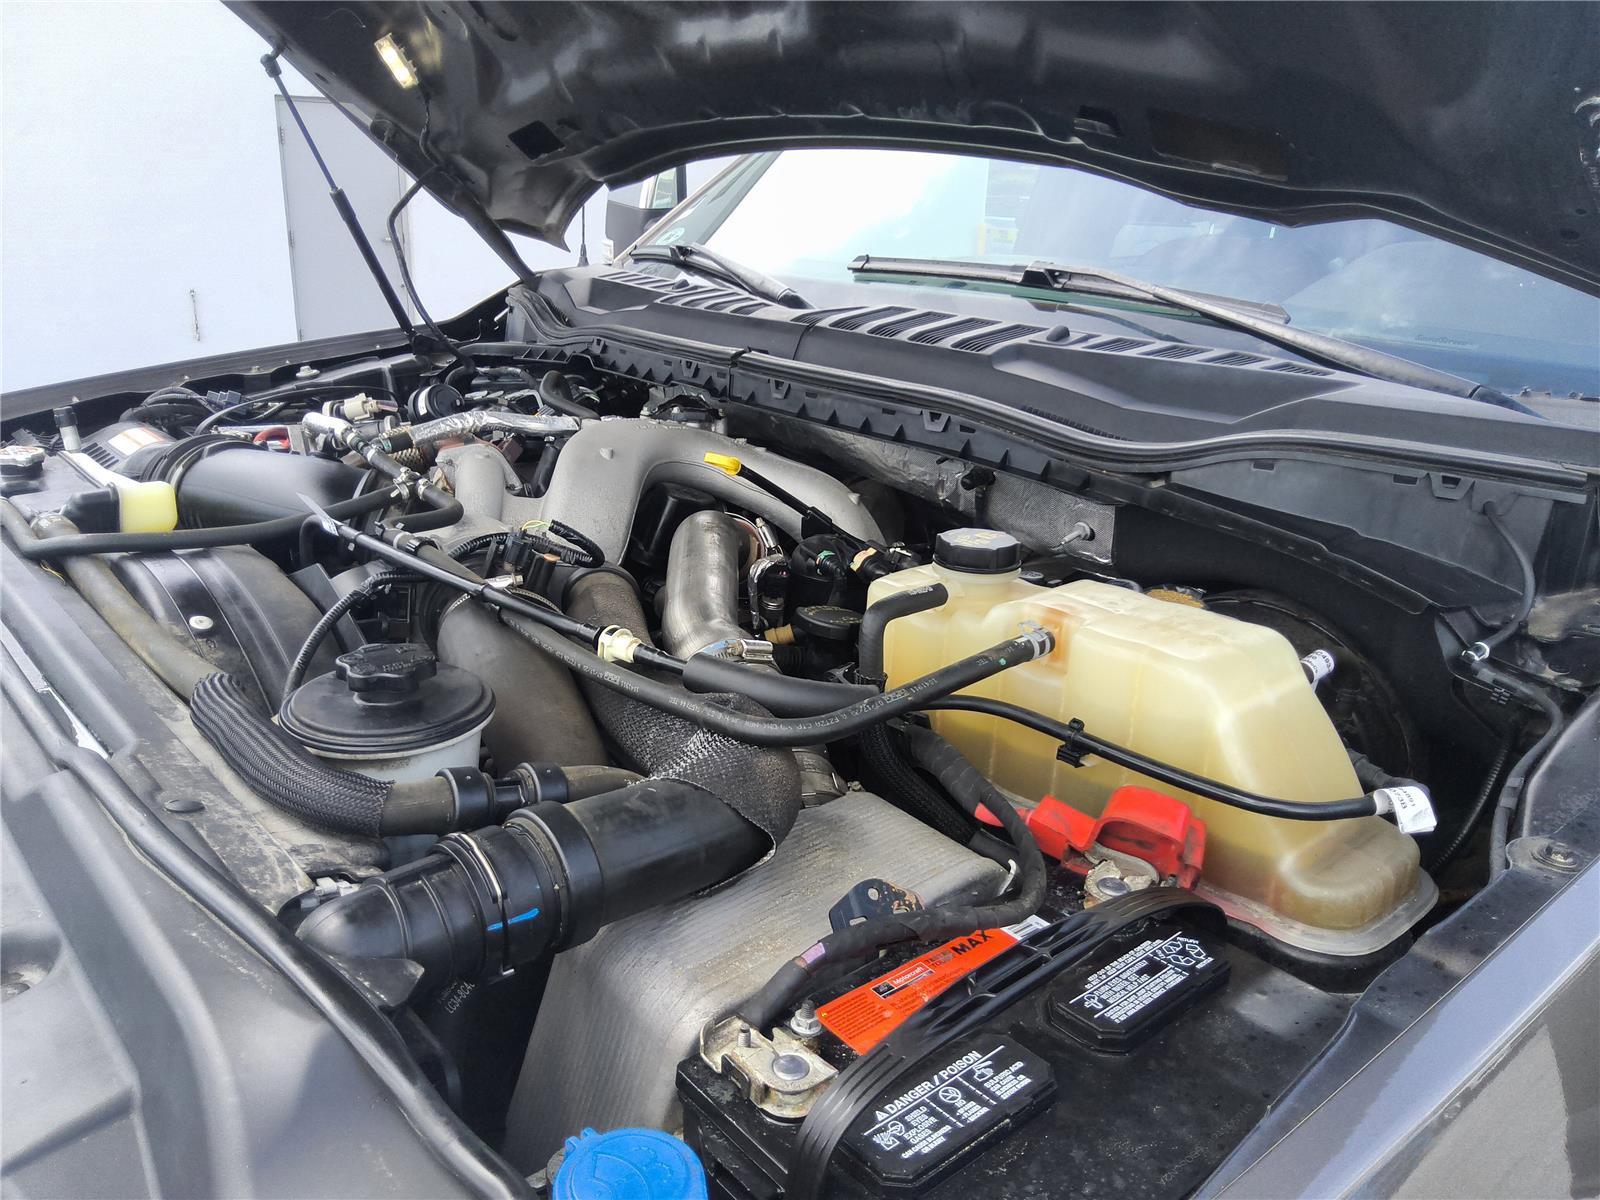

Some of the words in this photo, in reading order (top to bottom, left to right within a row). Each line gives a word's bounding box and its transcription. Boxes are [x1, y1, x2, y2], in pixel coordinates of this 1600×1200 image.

[951, 929, 992, 955] MAX
[892, 966, 925, 985] Motorcraft
[884, 1081, 935, 1114] DANGER
[939, 1050, 983, 1080] POISON
[983, 1069, 1013, 1088] SULFURIC
[1009, 1061, 1024, 1073] ACID
[904, 1106, 928, 1122] SHIELD
[910, 1113, 929, 1127] EYES
[903, 1116, 938, 1140] EXPLOSIVE
